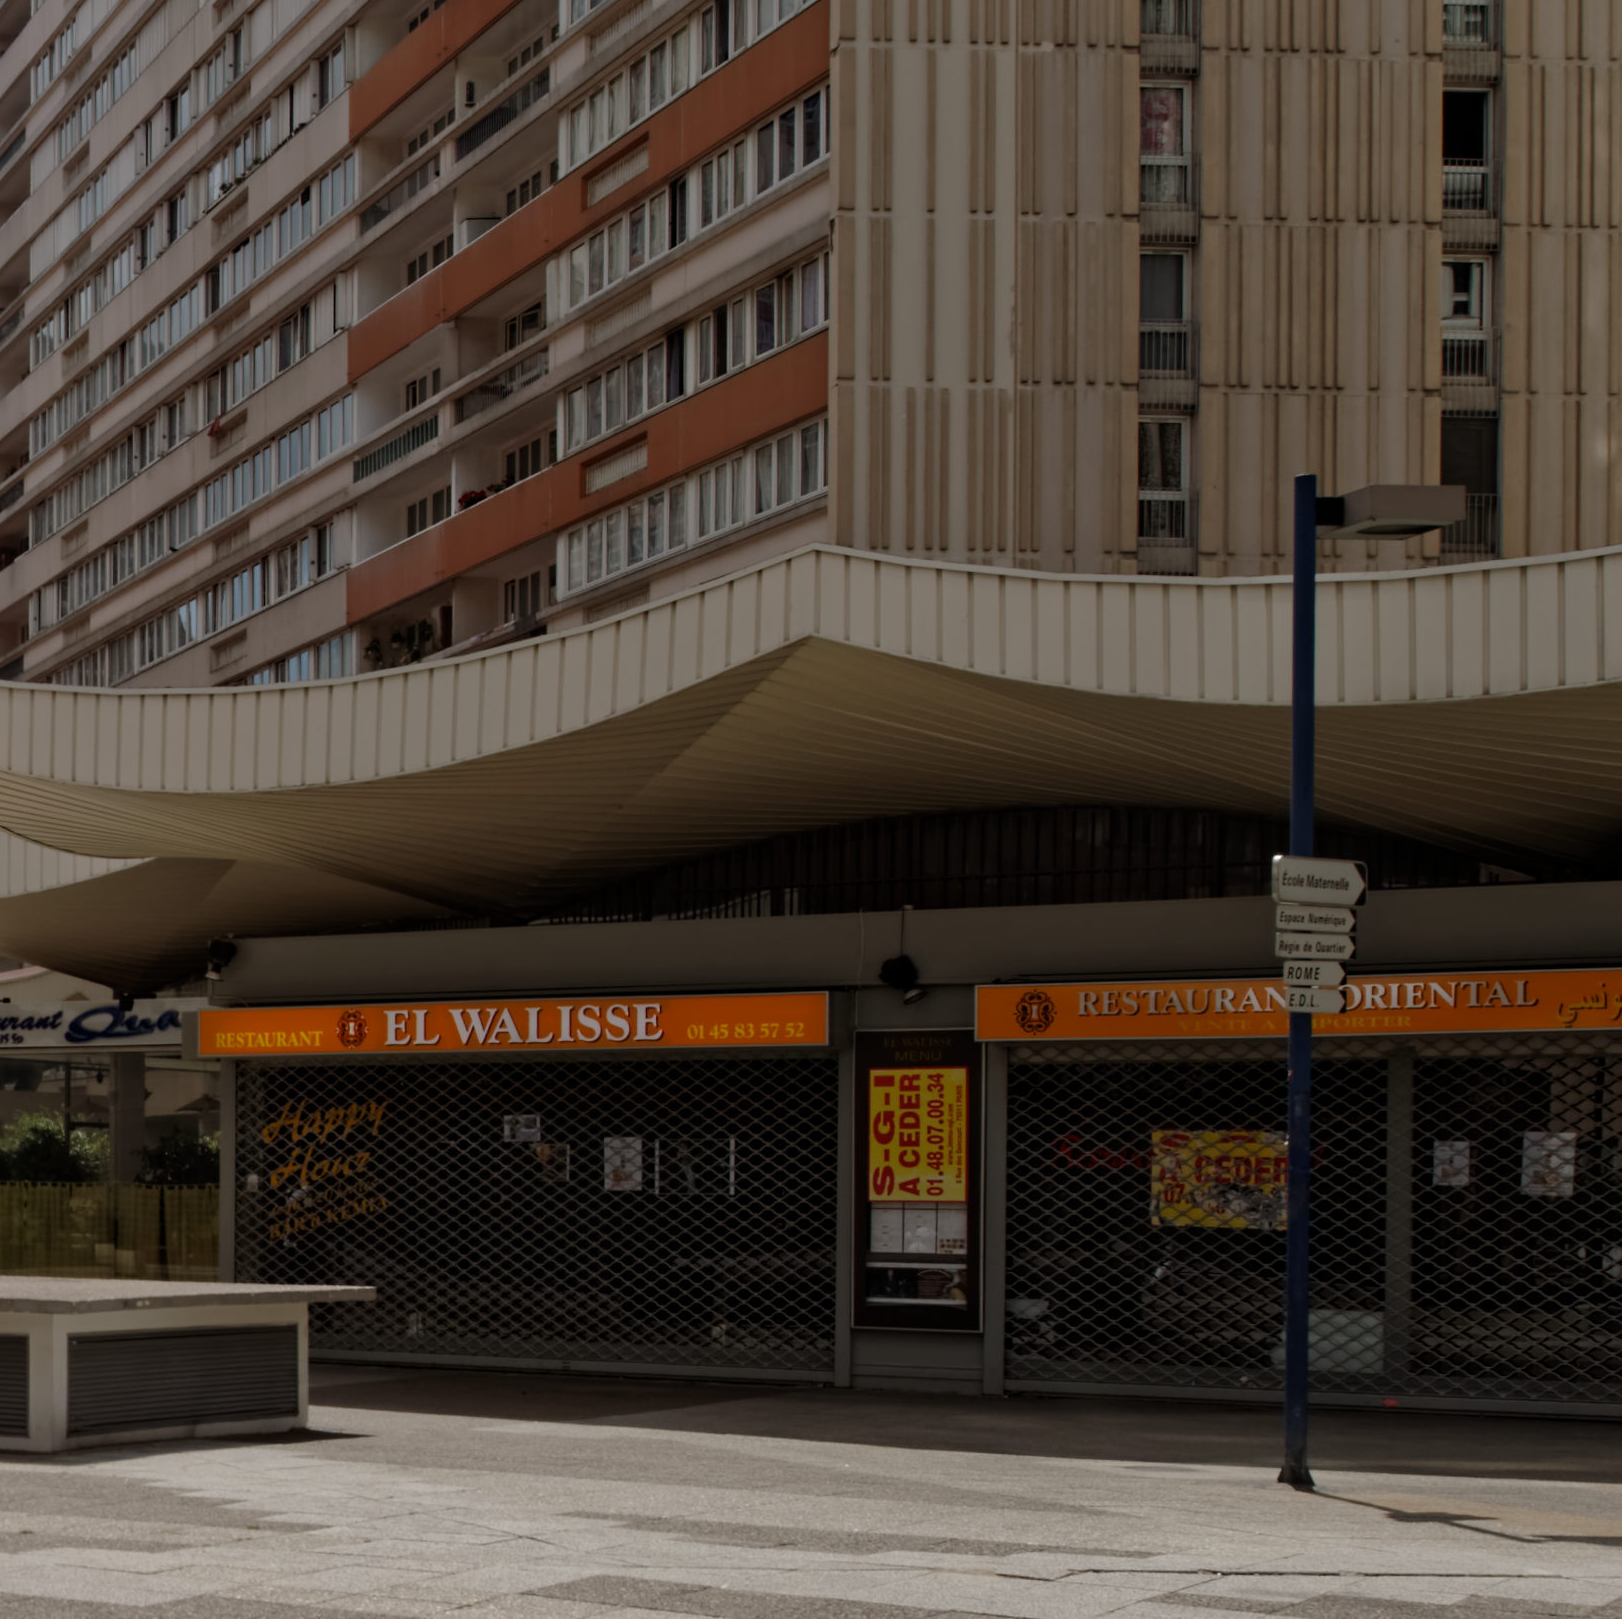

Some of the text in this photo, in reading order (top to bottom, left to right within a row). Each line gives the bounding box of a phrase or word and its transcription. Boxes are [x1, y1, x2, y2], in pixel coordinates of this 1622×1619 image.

[1282, 869, 1350, 891] École Maternelle
[1279, 911, 1347, 928] Espace Numérique
[1278, 939, 1347, 955] Régie de Quartier
[1287, 966, 1320, 980] ROME
[1077, 980, 1539, 1017] RESTAURAN ORIENTAL
[1289, 993, 1320, 1008] E.D.L.
[383, 1003, 664, 1047] EL WALISSE
[687, 1022, 805, 1040] 01 45 83 57 52
[1179, 1016, 1412, 1032] VENTE A PORTER
[215, 1031, 323, 1049] RESTAURANT
[895, 1051, 942, 1062] MENU
[261, 1098, 388, 1145] Happy
[898, 1074, 920, 1197] A CEDER
[926, 1073, 944, 1196] 01.48.07.00.34
[270, 1146, 371, 1189] Hour
